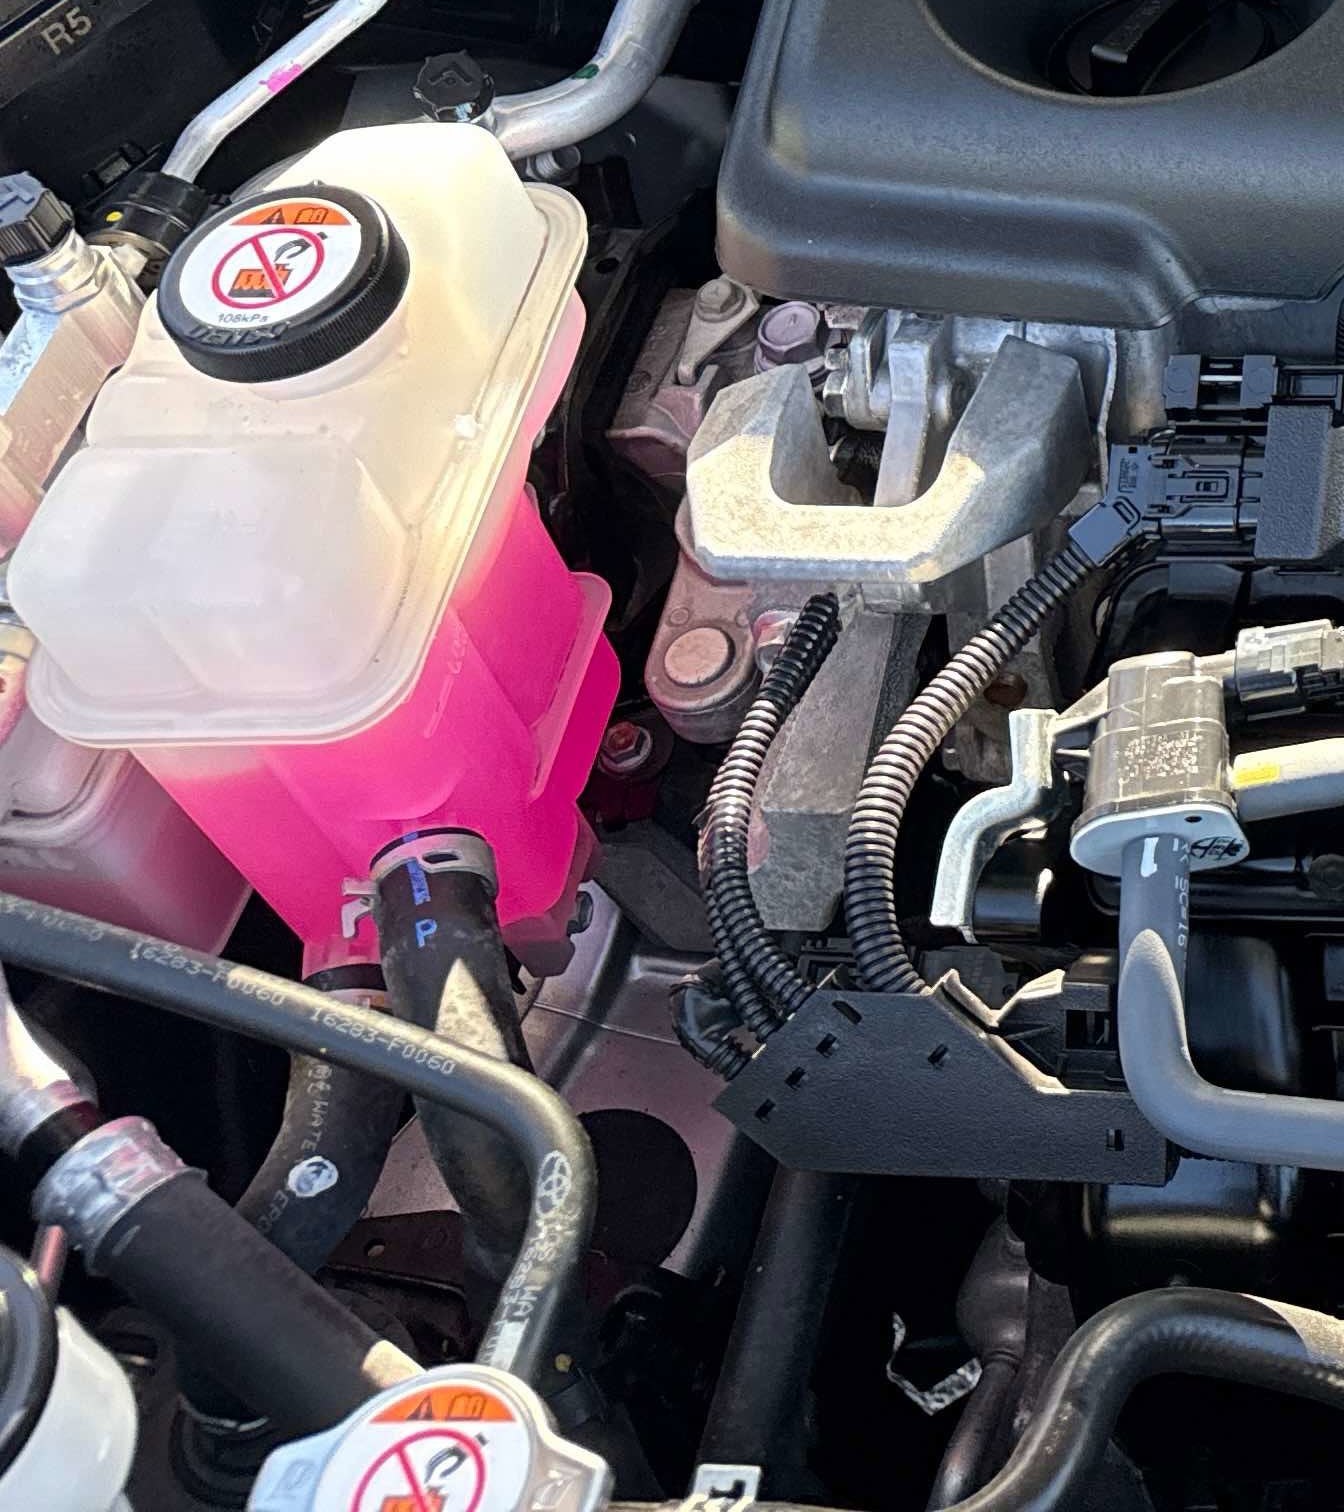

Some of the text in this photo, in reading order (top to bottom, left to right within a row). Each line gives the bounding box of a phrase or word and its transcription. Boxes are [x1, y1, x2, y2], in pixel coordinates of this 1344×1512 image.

[40, 5, 93, 56] R5
[415, 918, 438, 949] P
[310, 1004, 458, 1076] 16283-F0060
